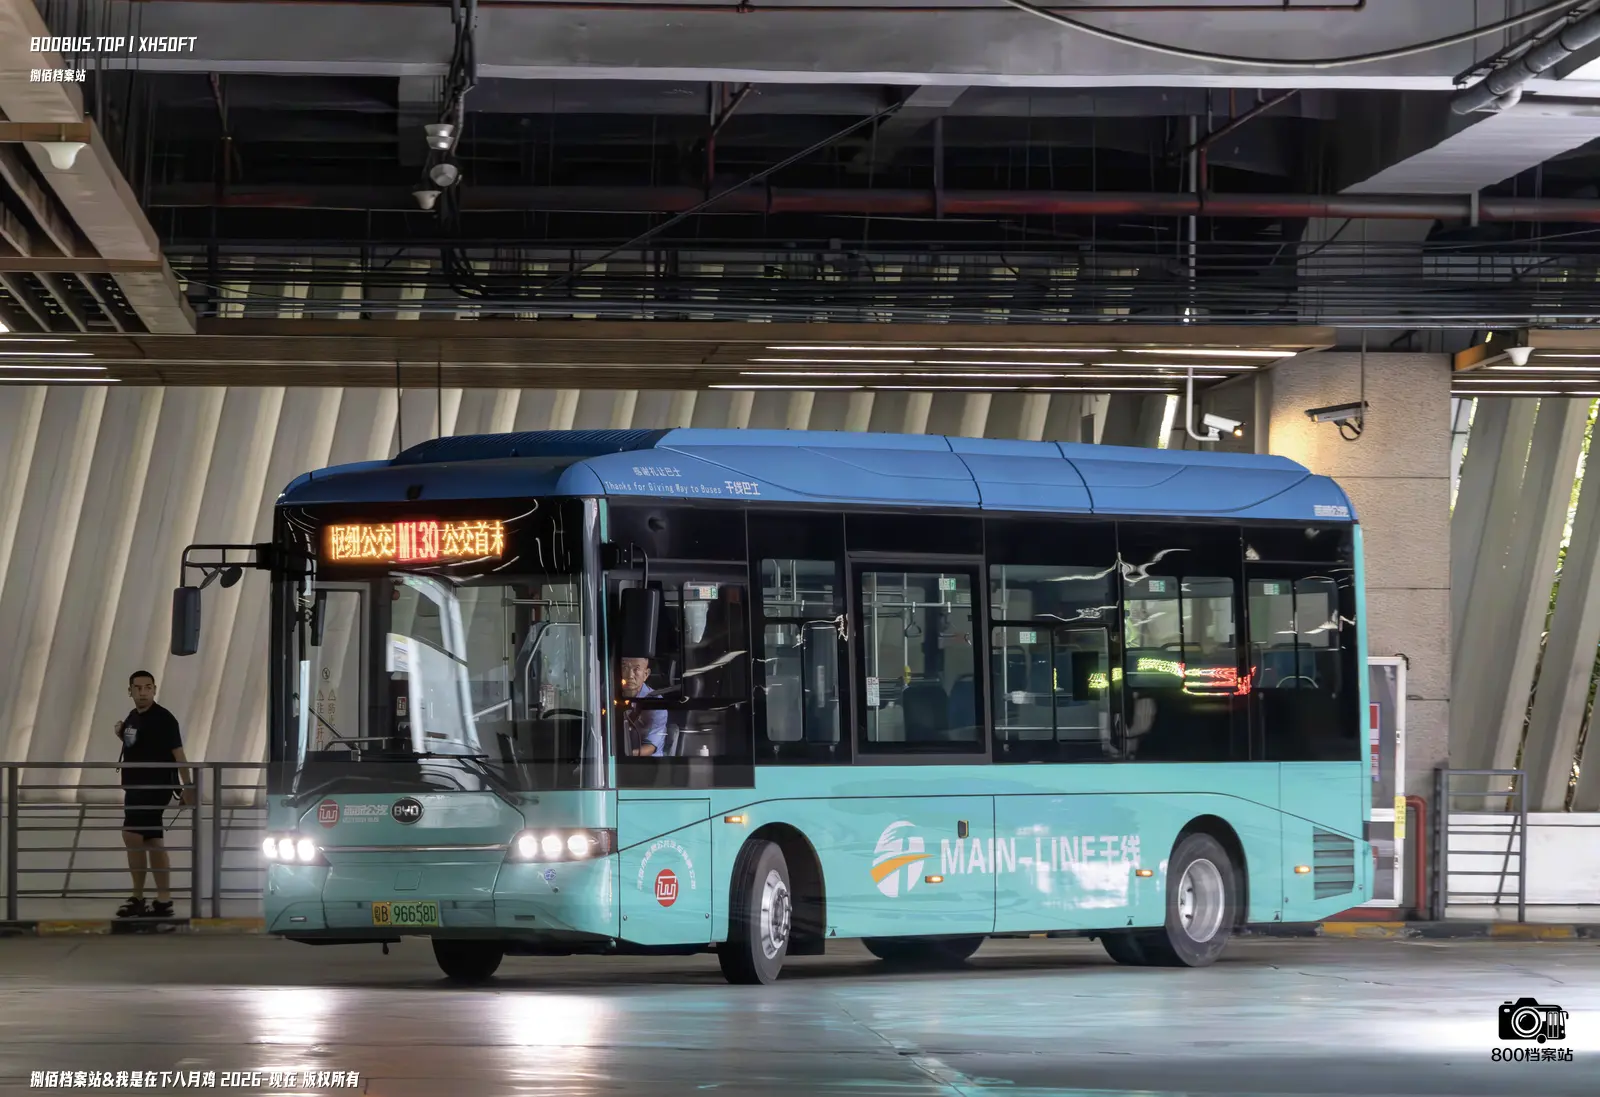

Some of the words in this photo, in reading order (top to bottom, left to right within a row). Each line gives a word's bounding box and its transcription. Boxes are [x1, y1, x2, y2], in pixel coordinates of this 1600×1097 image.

[605, 481, 631, 492] Thanks
[634, 481, 646, 491] for
[648, 482, 674, 493] Giving
[676, 483, 688, 494] Way
[690, 484, 699, 493] to
[701, 484, 721, 494] Buses
[724, 480, 761, 496] 干线巴士
[398, 521, 439, 559] M130
[394, 805, 419, 818] BYD
